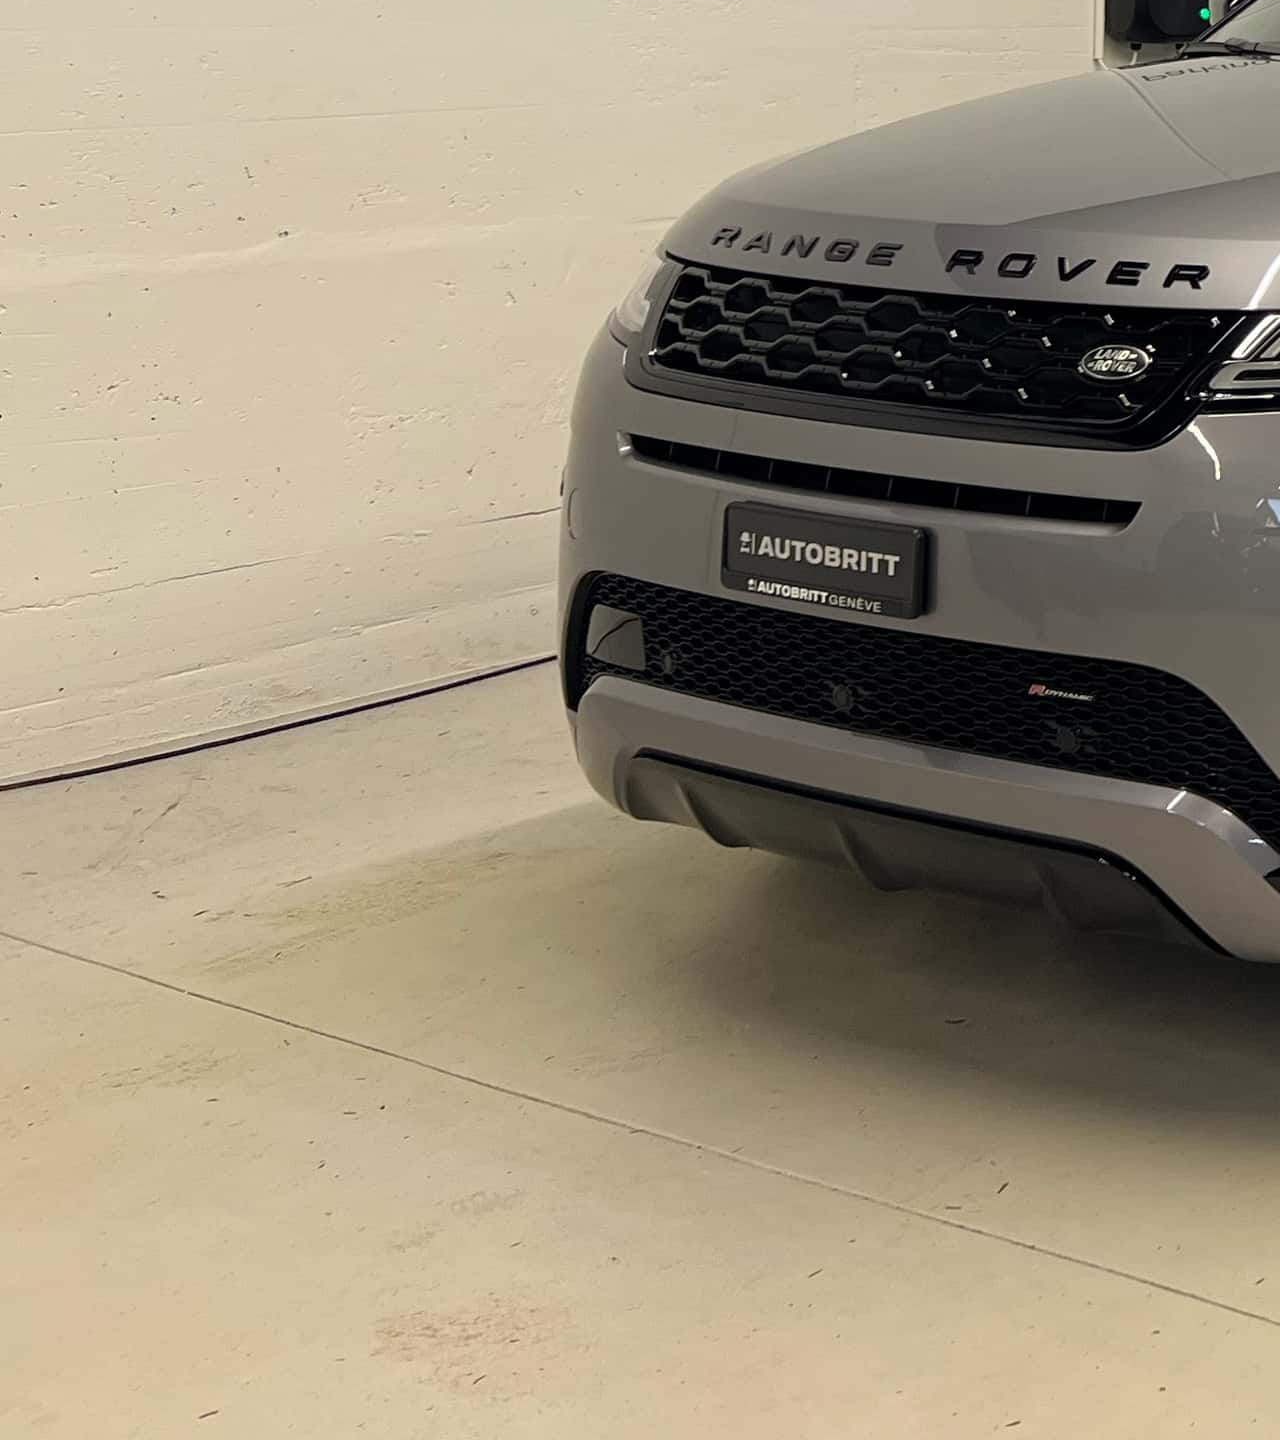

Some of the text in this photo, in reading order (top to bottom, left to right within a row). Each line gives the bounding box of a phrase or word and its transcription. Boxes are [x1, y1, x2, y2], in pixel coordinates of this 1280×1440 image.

[711, 227, 1211, 290] RANGE ROVER
[757, 535, 900, 576] AUTOBRITT
[756, 580, 829, 605] AUTOBRITT
